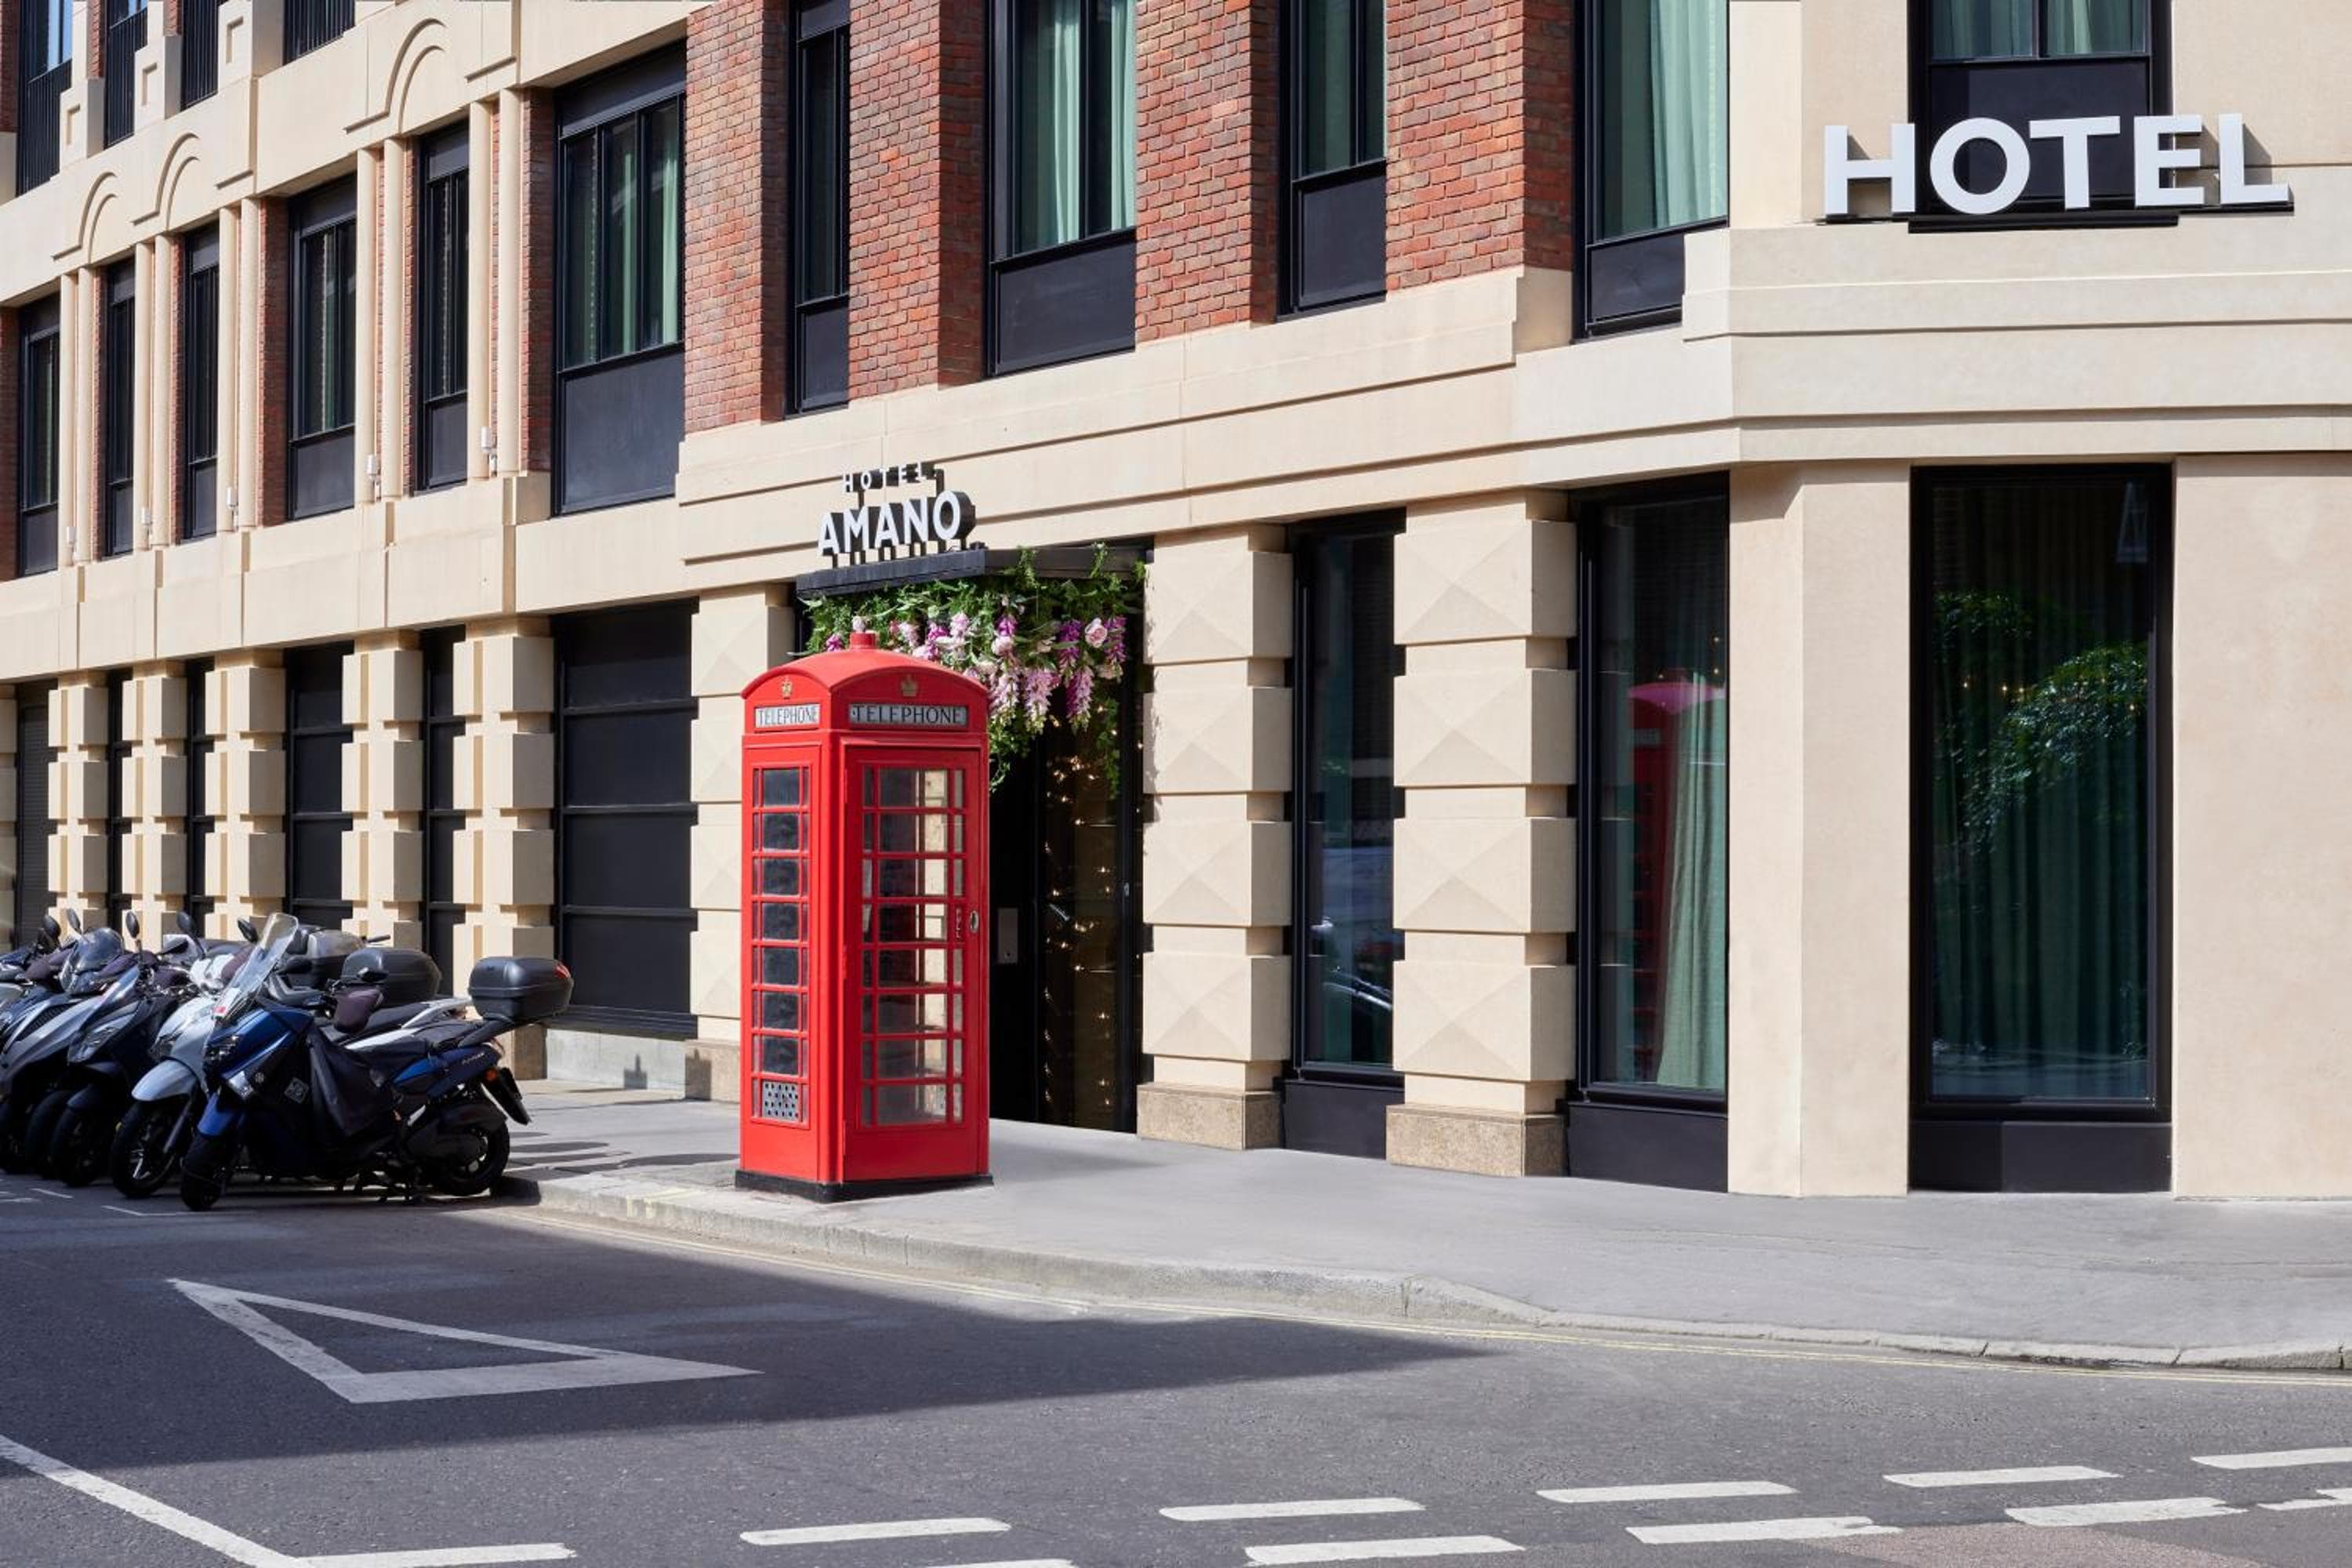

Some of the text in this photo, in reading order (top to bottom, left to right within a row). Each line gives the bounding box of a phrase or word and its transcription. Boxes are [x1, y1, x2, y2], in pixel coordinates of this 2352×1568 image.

[1824, 113, 2289, 216] HOTEL
[843, 461, 927, 494] HOTEL
[817, 490, 961, 556] AMANO
[758, 706, 818, 726] TELEPHONE
[853, 706, 961, 724] TELEPHONE
